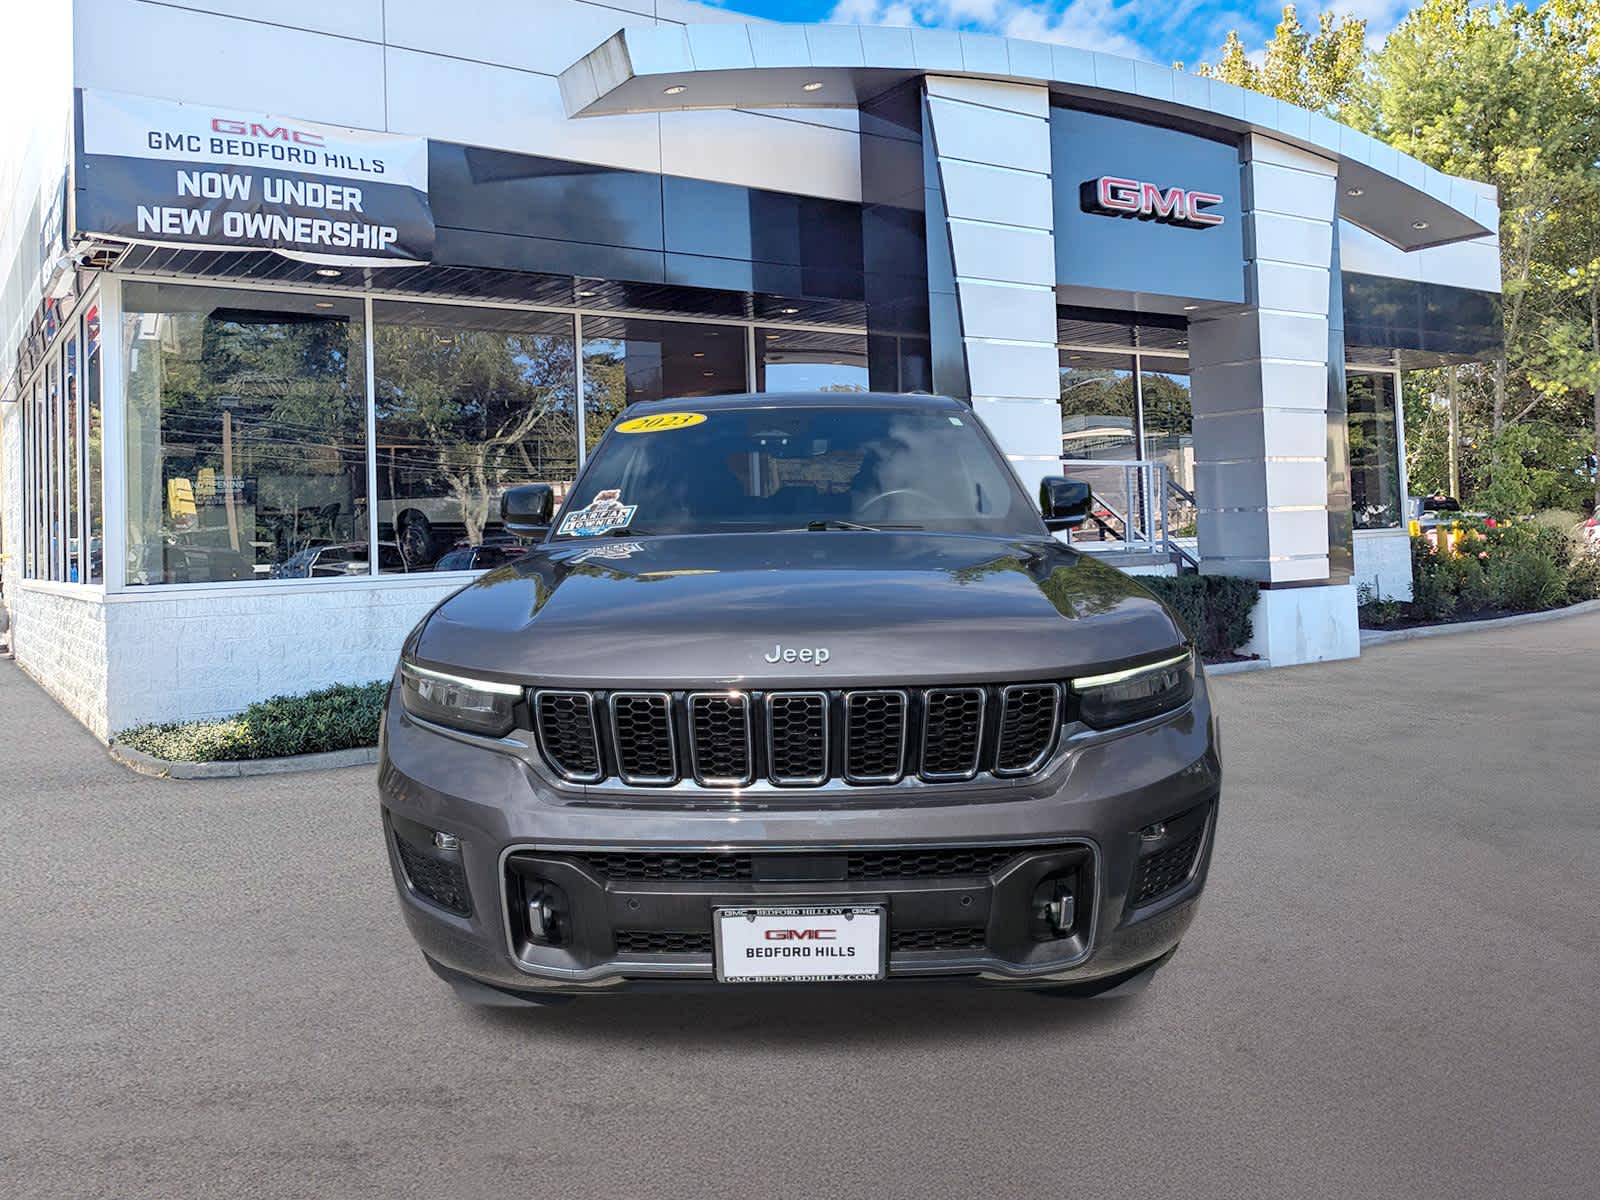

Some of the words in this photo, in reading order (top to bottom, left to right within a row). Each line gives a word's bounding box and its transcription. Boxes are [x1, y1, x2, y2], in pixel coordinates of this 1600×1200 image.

[211, 118, 326, 148] GMC
[147, 131, 202, 153] GMC
[210, 139, 317, 166] BEDFORD
[324, 154, 385, 174] HILLS
[176, 170, 252, 201] NOW
[263, 176, 364, 213] UNDER
[1097, 175, 1225, 225] GMC
[136, 205, 212, 236] NEW
[223, 211, 398, 250] OWNERSHIP
[764, 644, 830, 666] Jeep
[756, 909, 800, 917] BEDFORD
[802, 908, 828, 916] HILLS
[764, 929, 837, 940] GMC
[746, 947, 811, 958] BEDFORD
[815, 946, 856, 958] HILLS
[727, 974, 876, 983] GMCBEDFORDHILLS.COM
